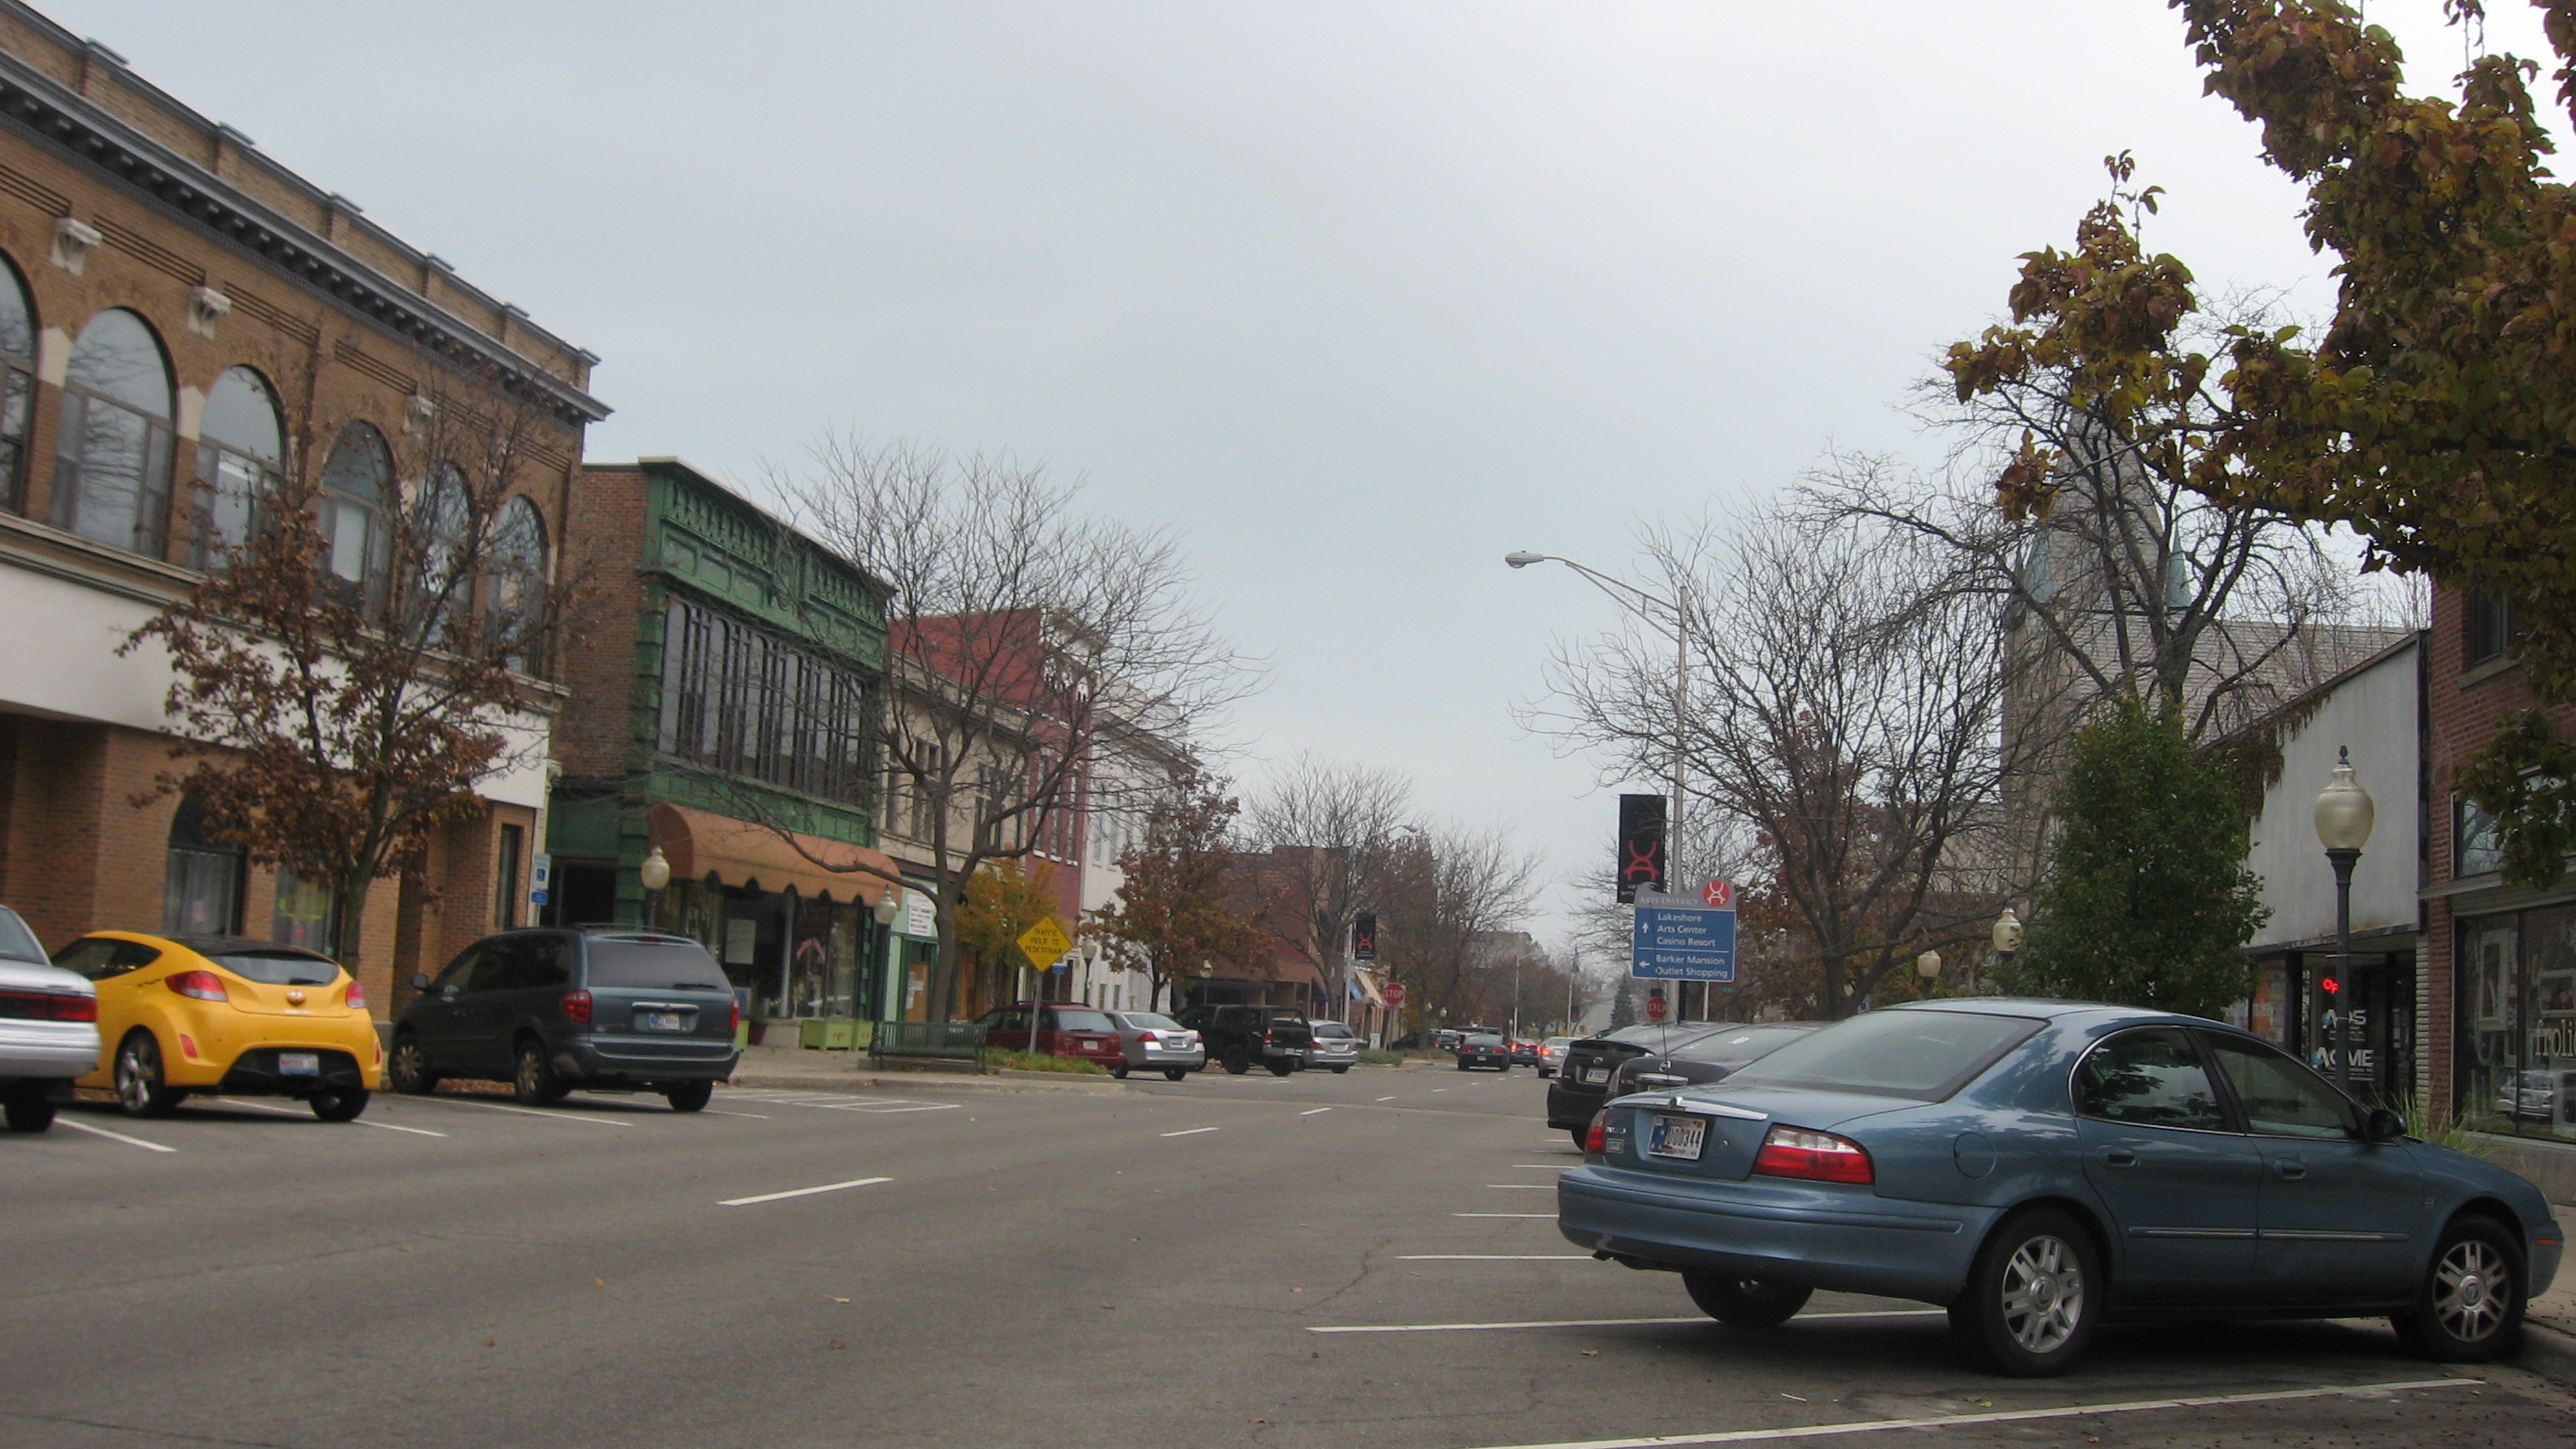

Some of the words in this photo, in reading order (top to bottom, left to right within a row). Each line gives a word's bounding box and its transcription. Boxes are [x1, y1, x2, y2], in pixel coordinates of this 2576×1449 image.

[1661, 897, 1700, 906] DISTRICT
[1657, 913, 1703, 922] Lakeshore
[1657, 925, 1675, 933] Arts
[1678, 925, 1708, 934] Center
[1657, 937, 1686, 946] Casino
[1688, 938, 1716, 947] Resort
[1656, 955, 1684, 964] Barker
[1687, 956, 1726, 966] Mansion
[1655, 966, 1683, 976] Outlet
[1686, 967, 1729, 979] Shopping
[1384, 989, 1404, 998] STOP
[2534, 1018, 2576, 1058] froli
